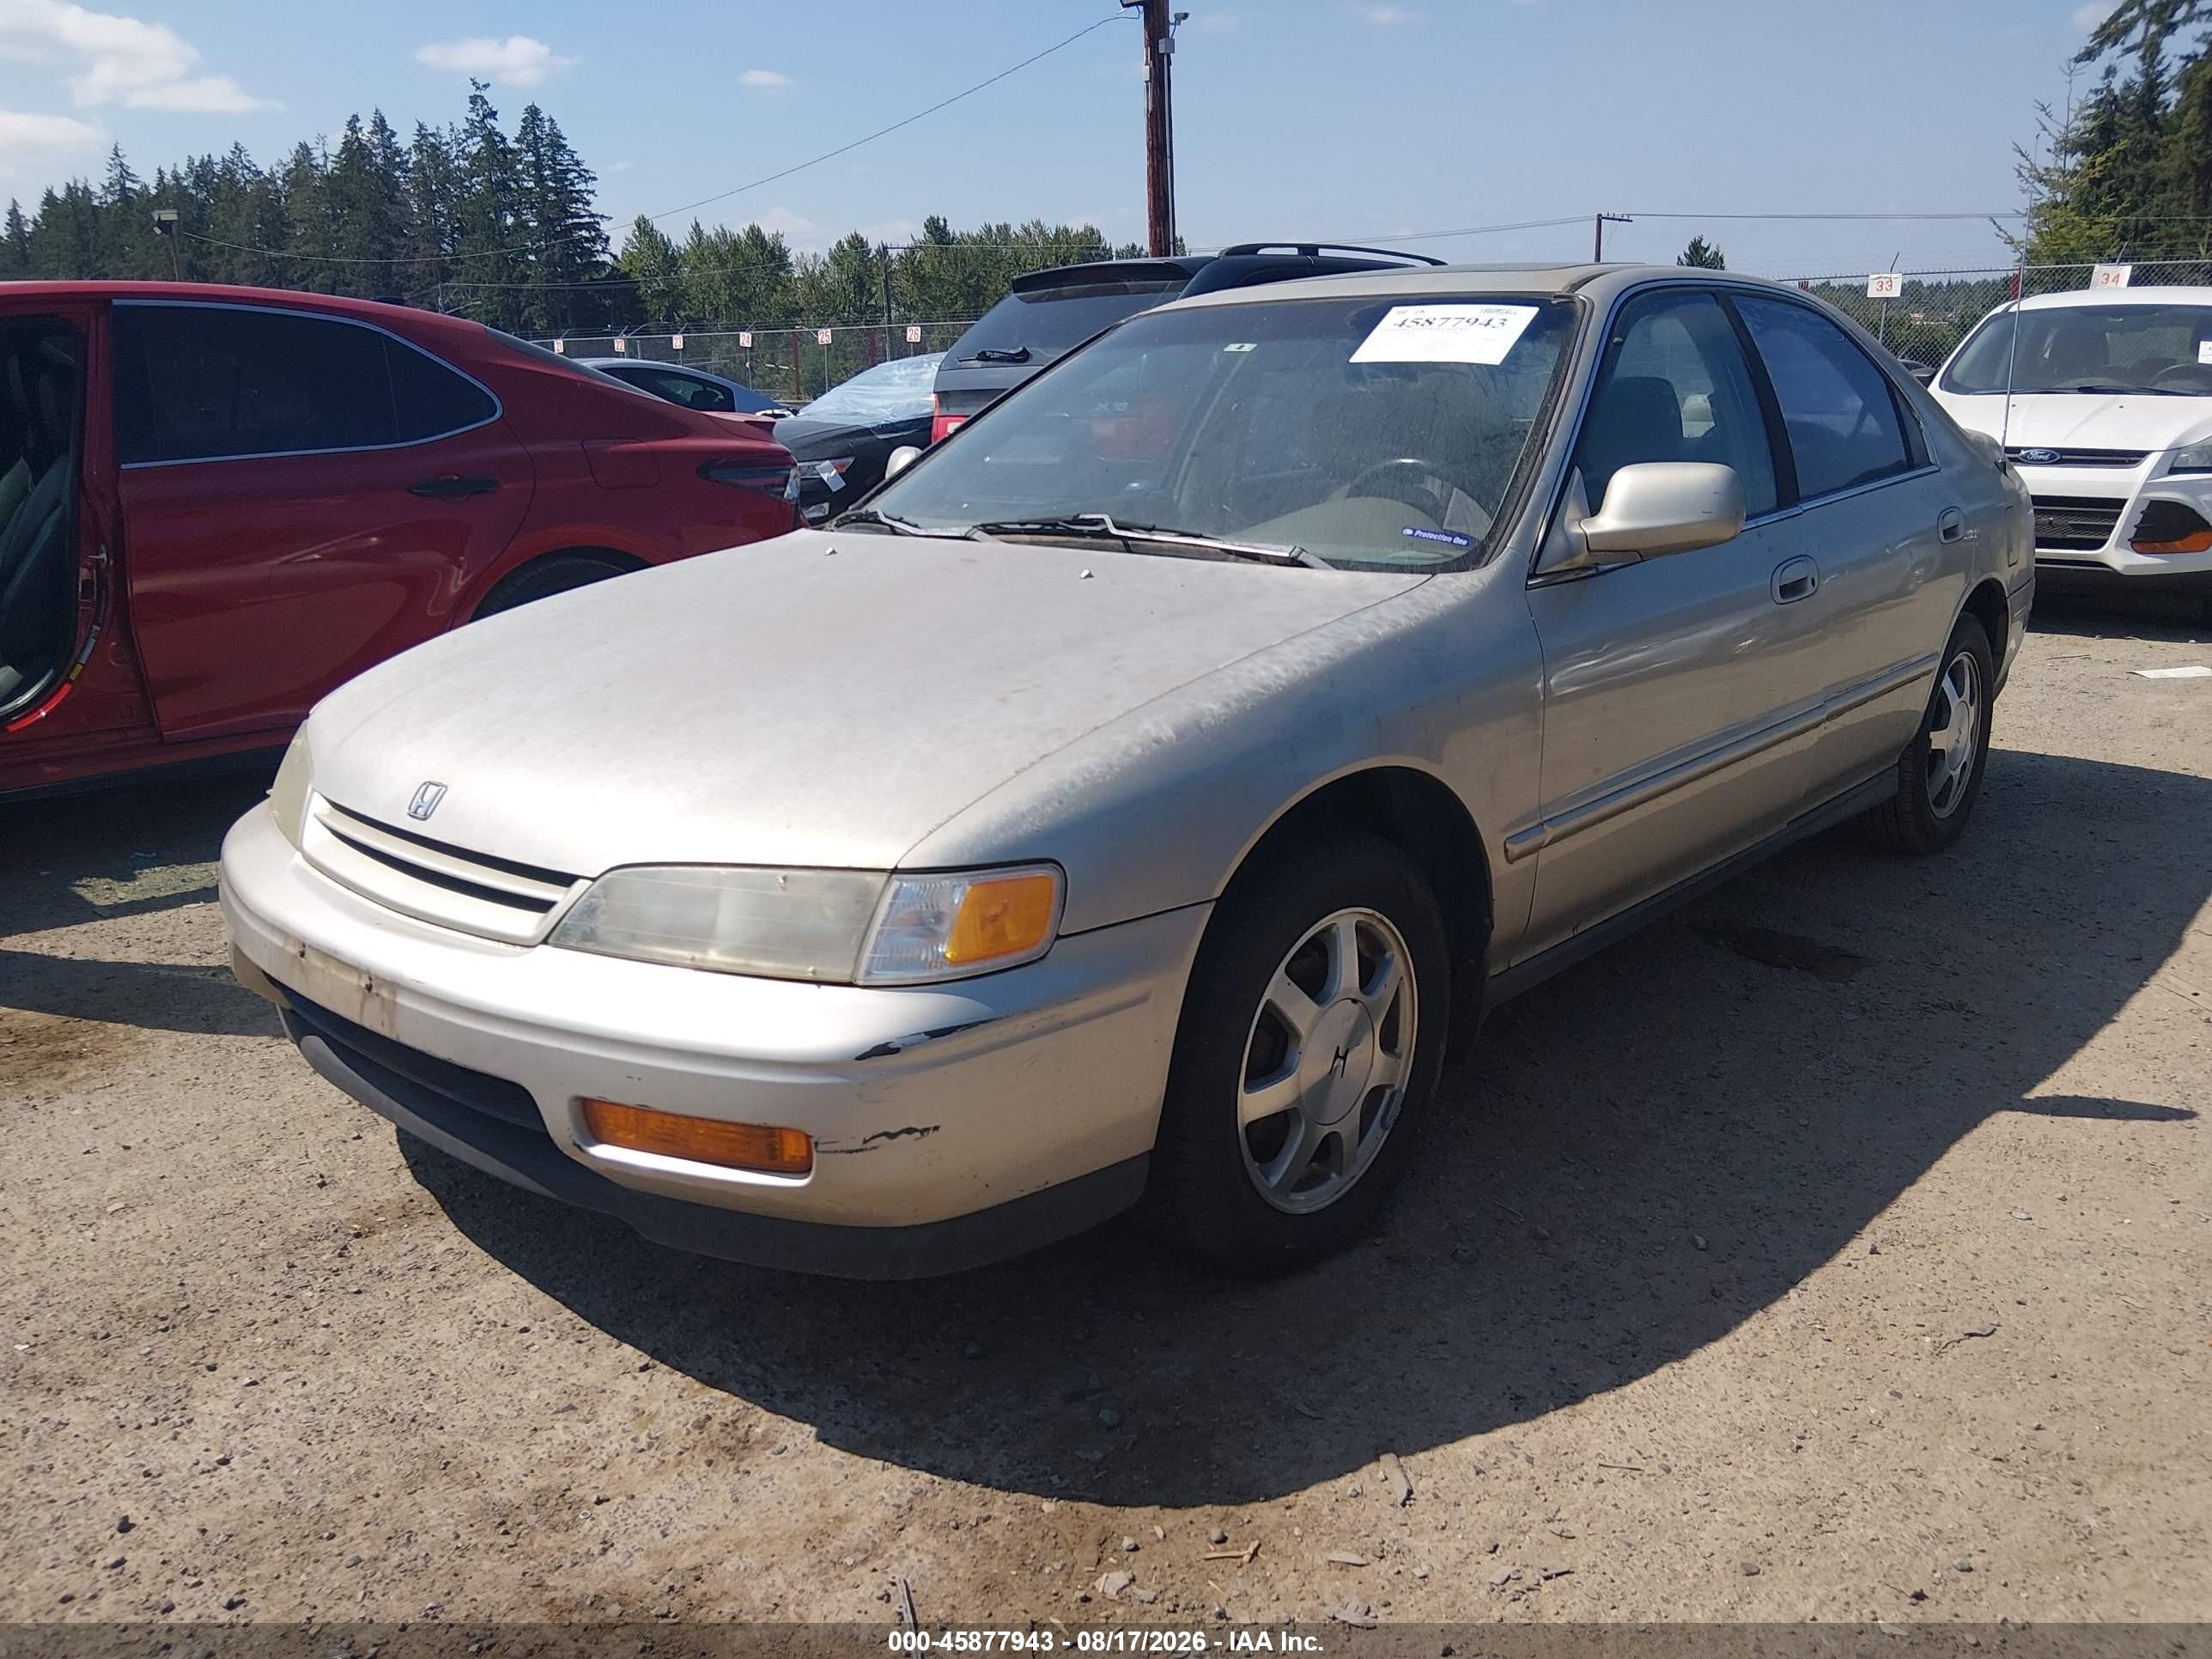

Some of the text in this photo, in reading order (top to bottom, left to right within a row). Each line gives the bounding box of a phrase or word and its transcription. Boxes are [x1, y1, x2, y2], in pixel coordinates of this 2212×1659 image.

[2100, 272, 2120, 285] 34
[1876, 280, 1893, 292] 33
[1394, 317, 1508, 329] 45877943
[741, 333, 750, 346] 24
[819, 330, 830, 343] 25
[909, 328, 920, 341] 26
[615, 339, 624, 351] 22
[673, 337, 682, 348] 23
[1414, 530, 1468, 546] Protection One
